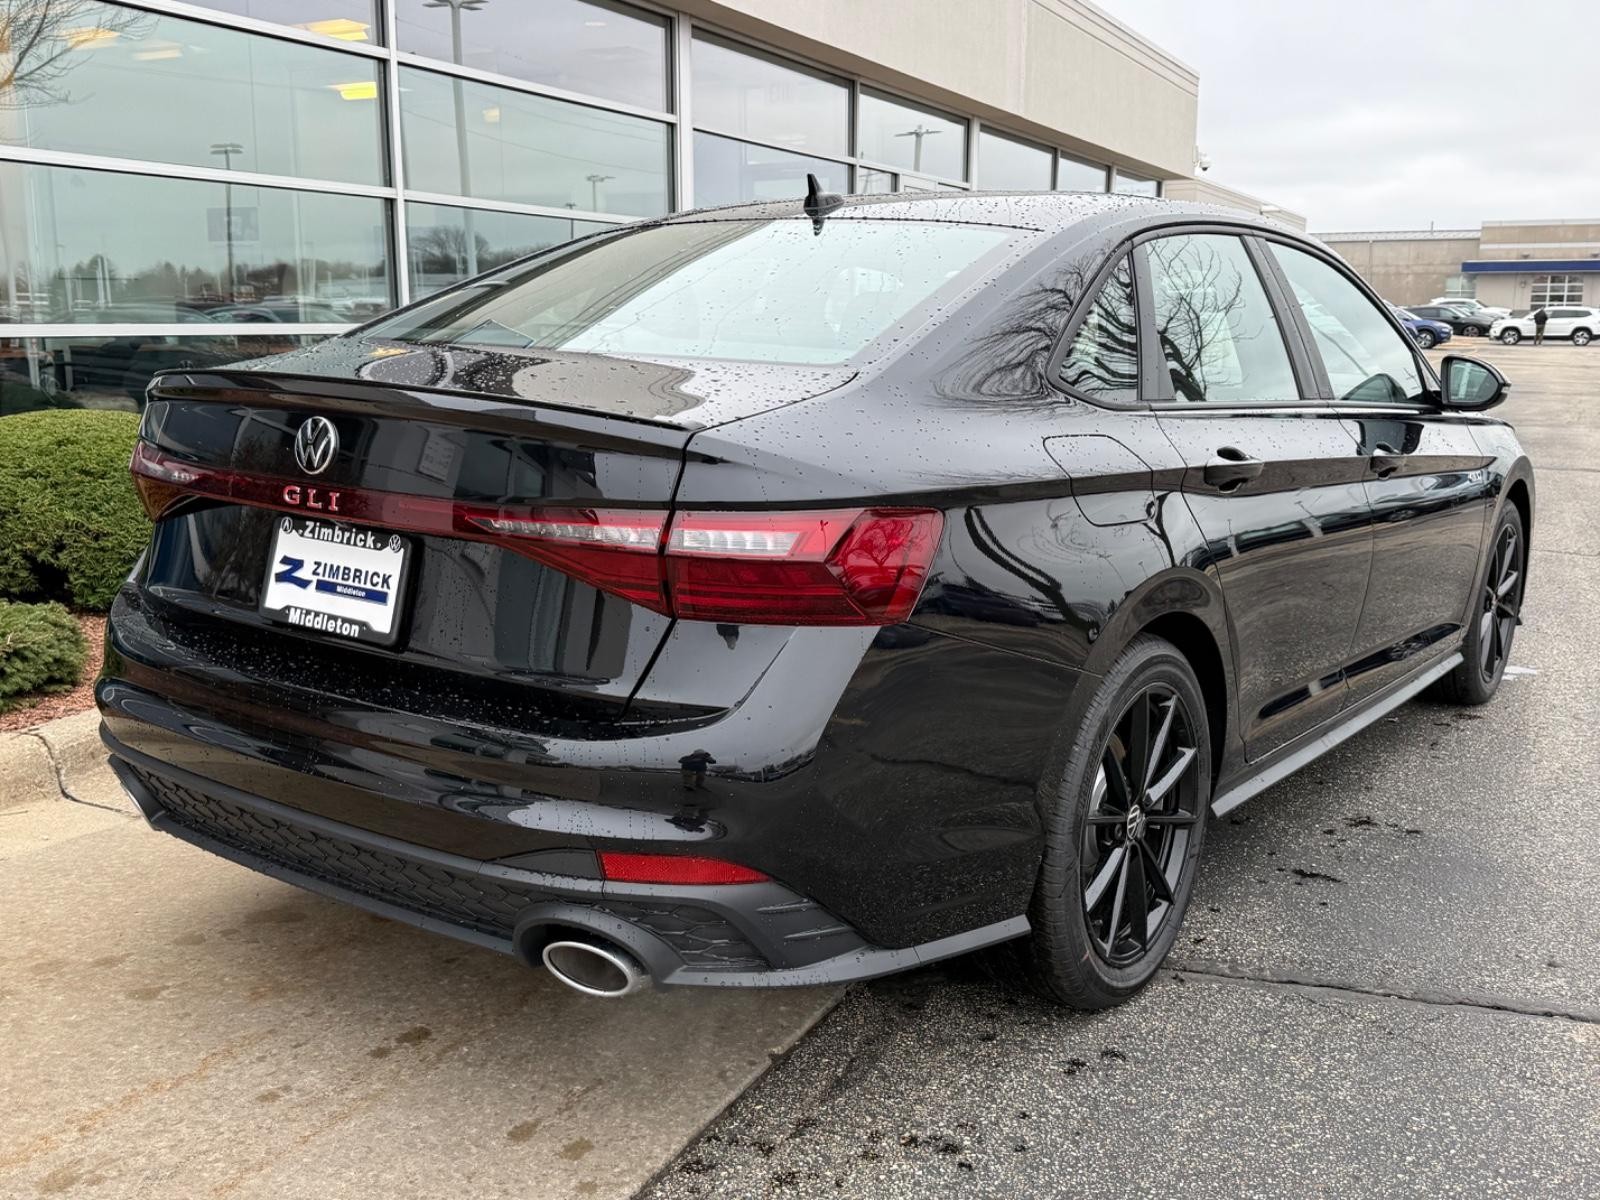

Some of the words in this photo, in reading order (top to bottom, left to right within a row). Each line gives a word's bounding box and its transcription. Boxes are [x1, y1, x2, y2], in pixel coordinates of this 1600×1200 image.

[283, 485, 340, 511] GLI
[303, 520, 376, 549] Zimbrick
[311, 560, 392, 590] ZIMBRICK
[288, 606, 360, 637] Middleton
